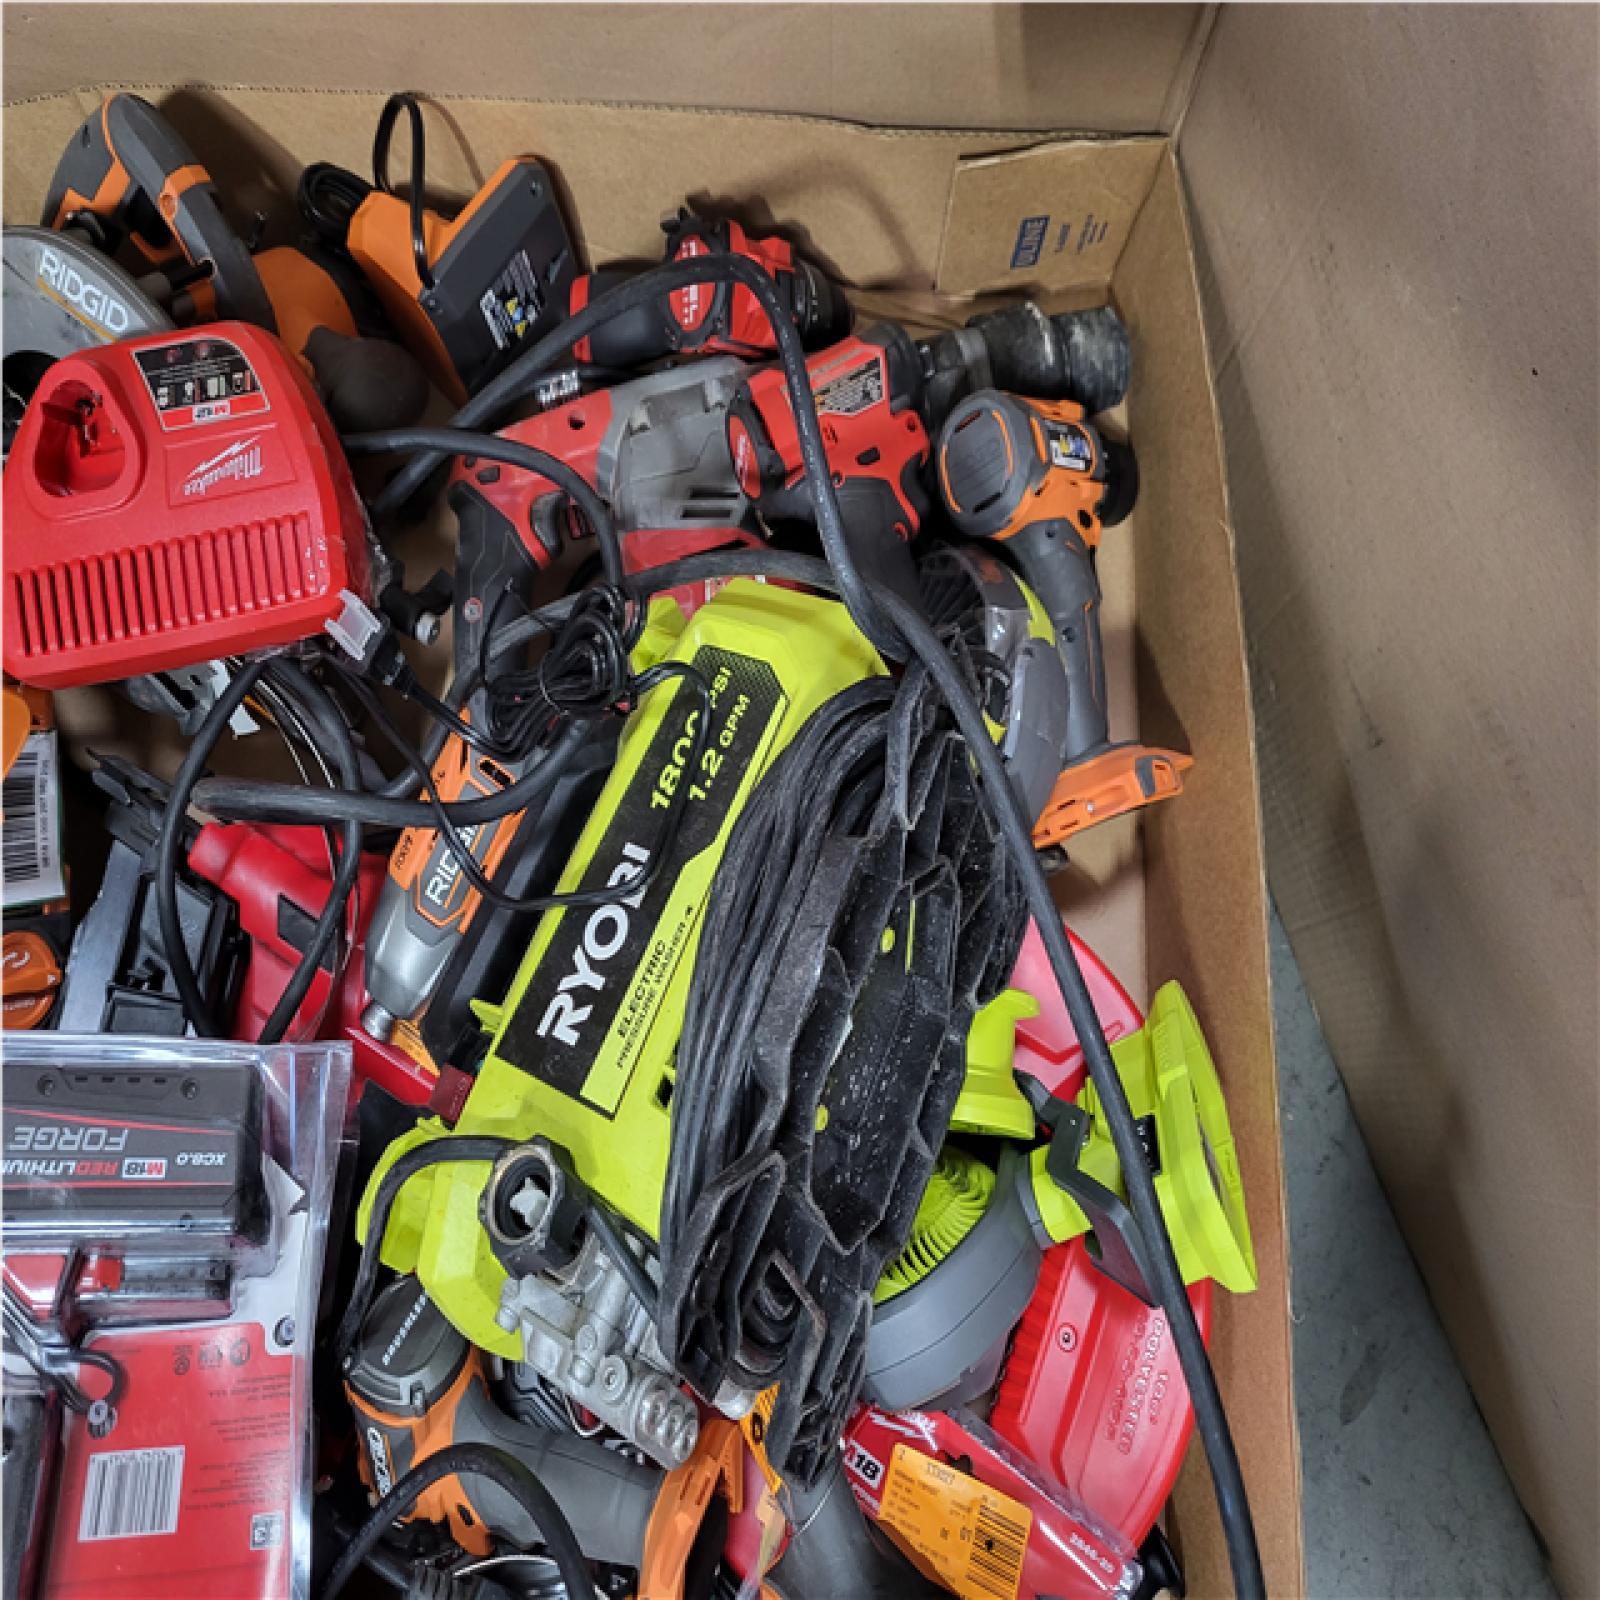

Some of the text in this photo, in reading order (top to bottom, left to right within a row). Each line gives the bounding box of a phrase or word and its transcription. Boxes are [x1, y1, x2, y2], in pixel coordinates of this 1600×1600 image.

[37, 248, 131, 333] RIDGID
[690, 694, 750, 800] 1.2 GPM
[616, 939, 665, 1038] ELECTRIC
[3, 1158, 164, 1176] M18 REDLITHIU
[8, 1127, 129, 1151] FORGE
